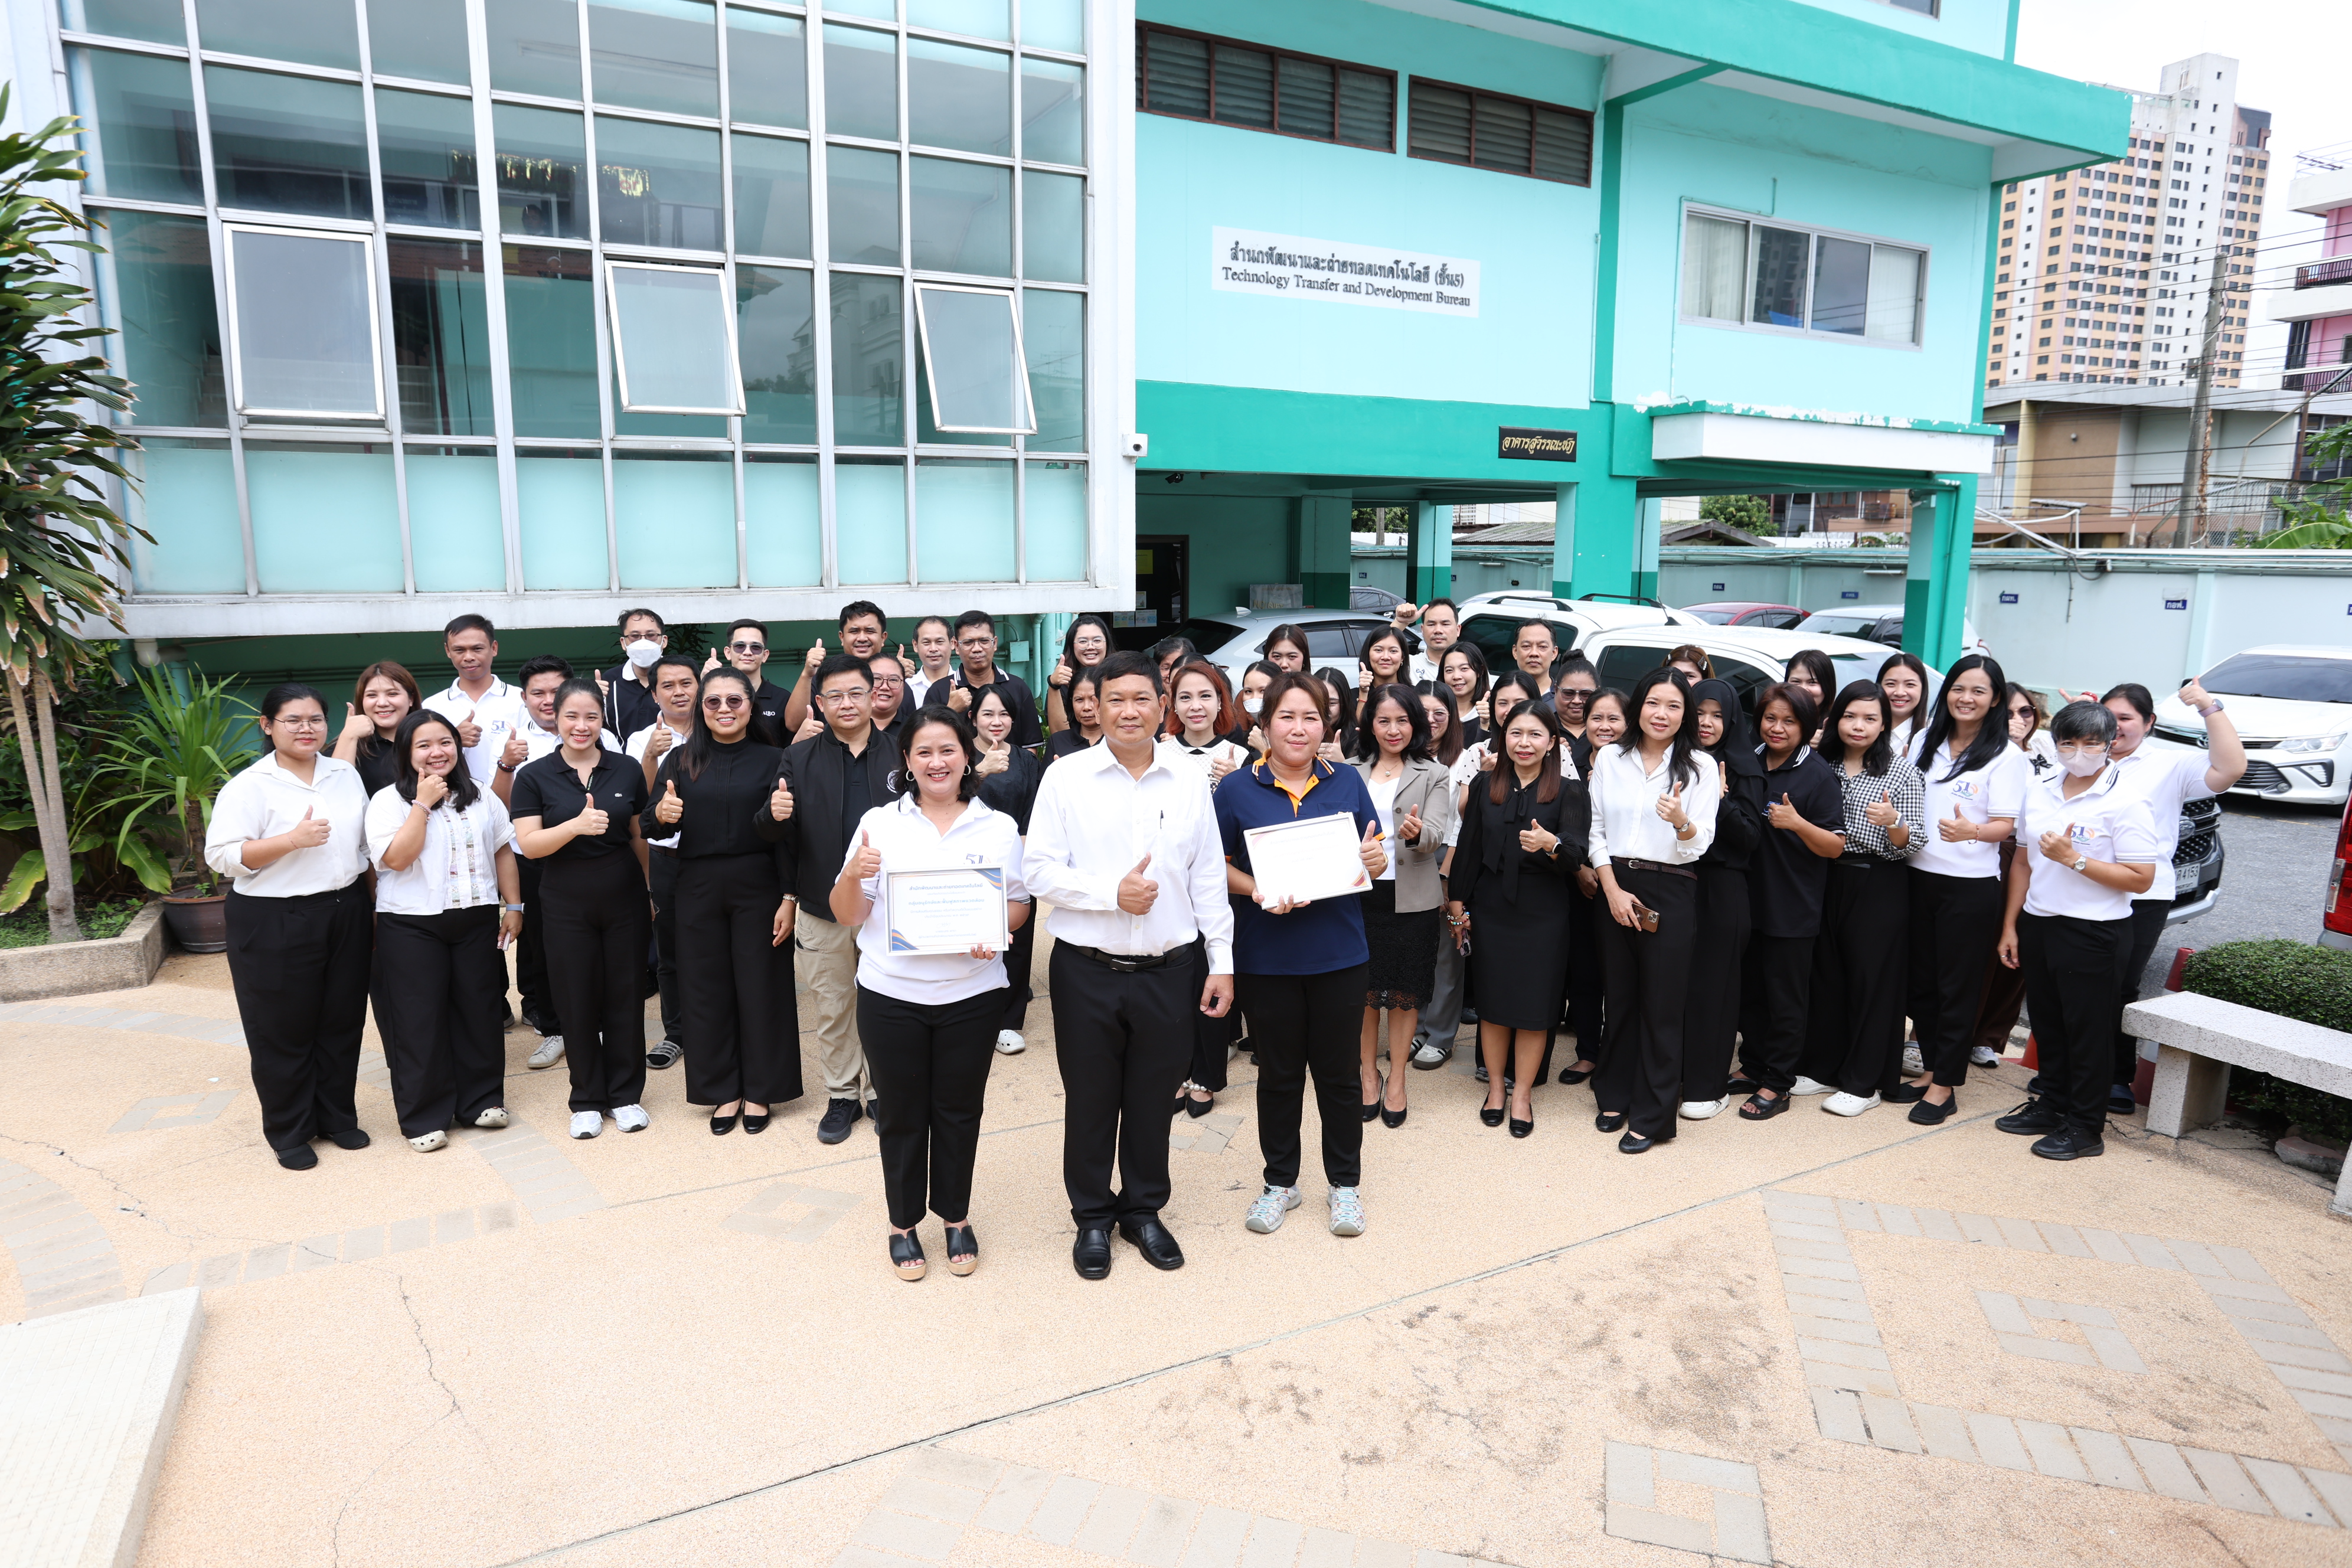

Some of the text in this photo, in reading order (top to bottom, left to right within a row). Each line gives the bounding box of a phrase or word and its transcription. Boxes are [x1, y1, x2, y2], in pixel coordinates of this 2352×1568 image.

[1435, 263, 1464, 288] (ชั้น5)
[1222, 267, 1471, 306] Technology Transfer and Development Bureau
[491, 720, 505, 731] 51
[1952, 780, 1970, 792] 51
[2182, 865, 2199, 880] 4153
